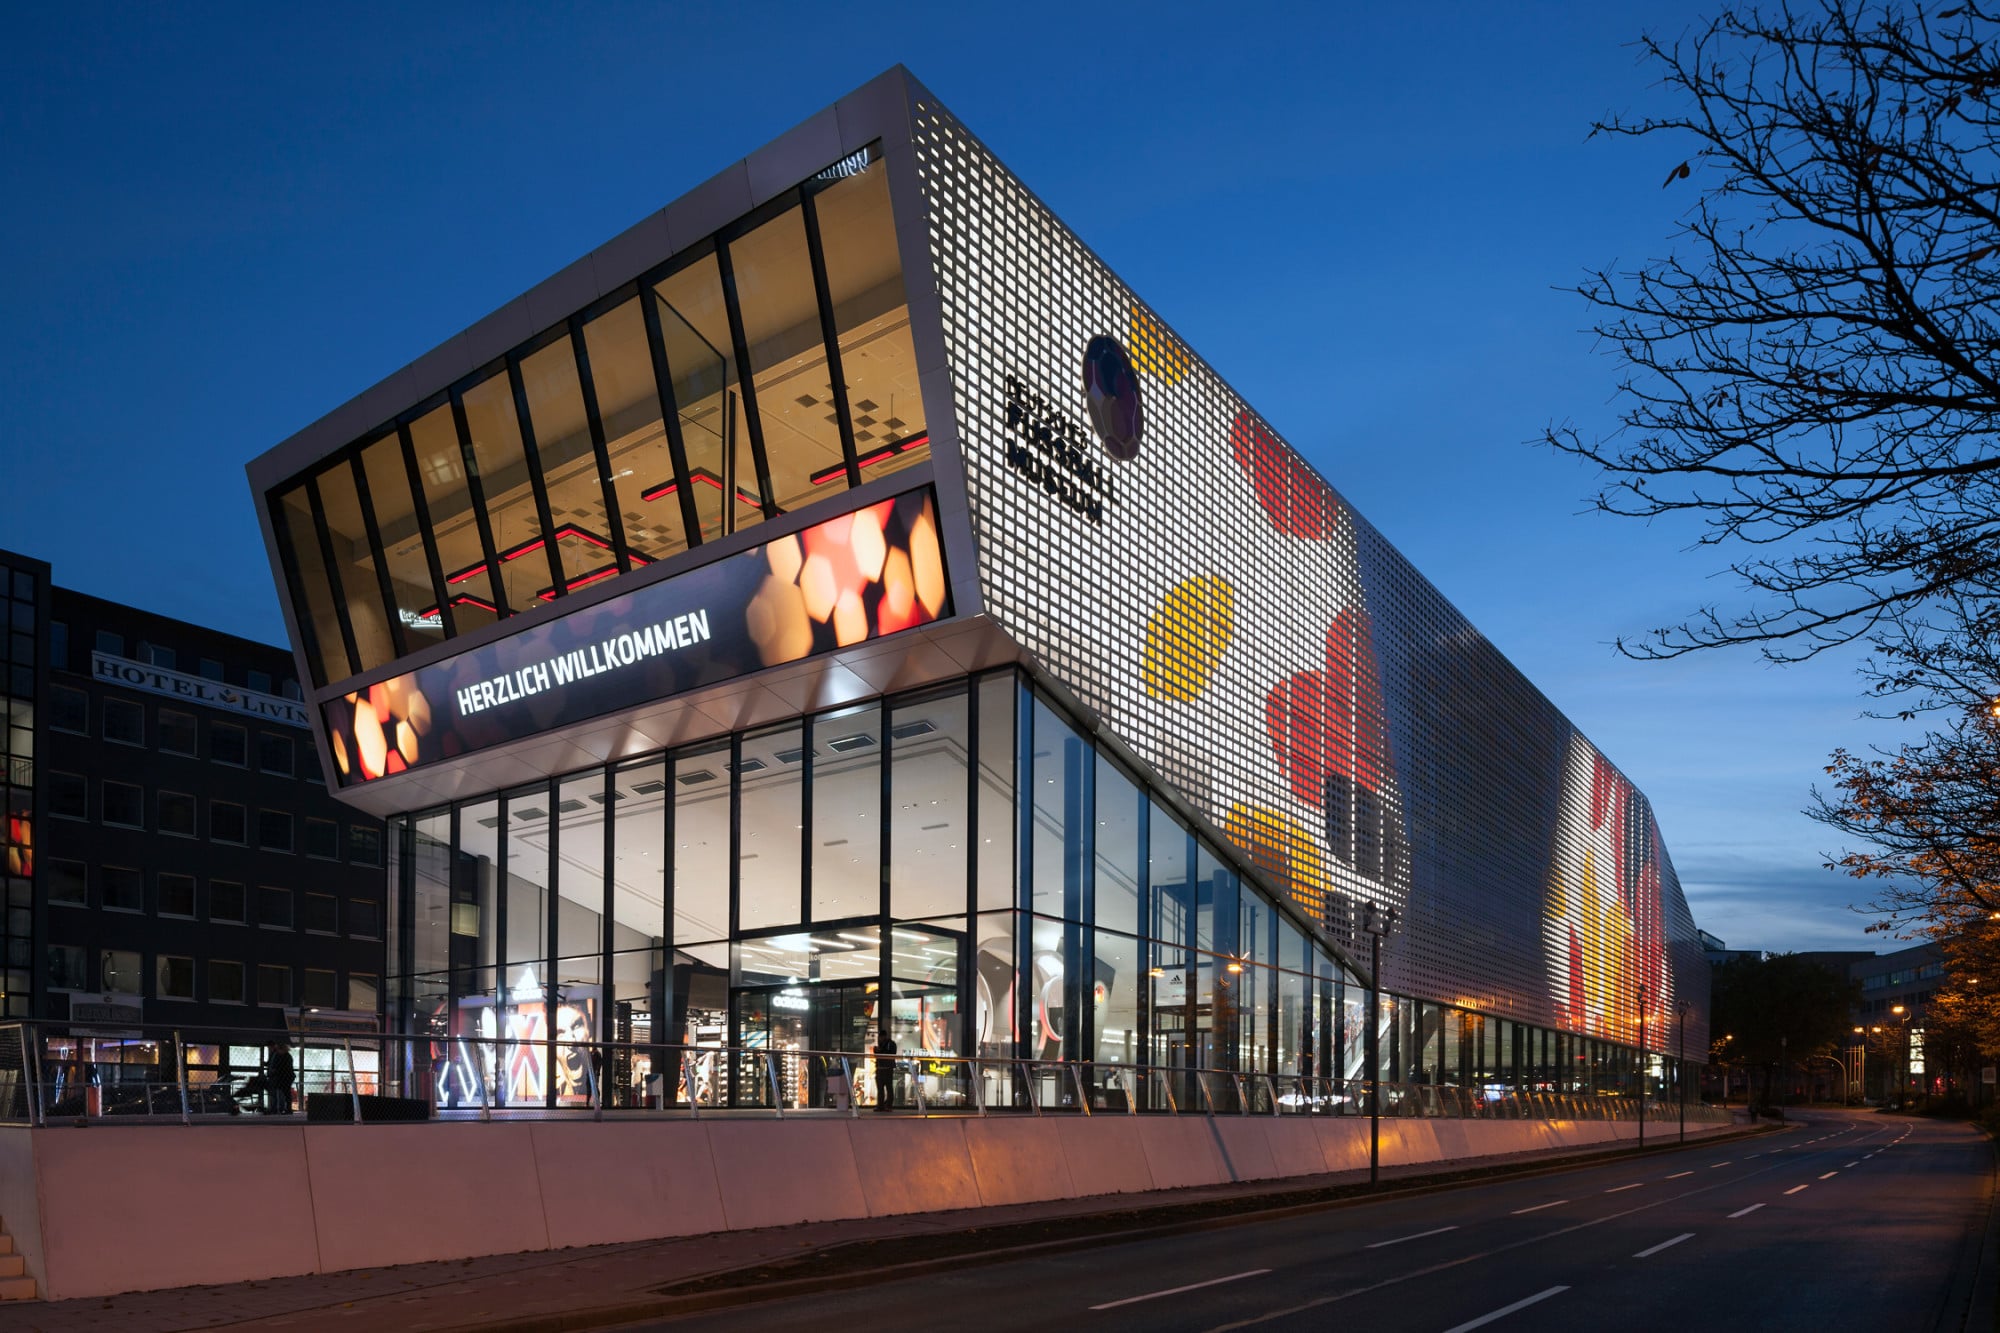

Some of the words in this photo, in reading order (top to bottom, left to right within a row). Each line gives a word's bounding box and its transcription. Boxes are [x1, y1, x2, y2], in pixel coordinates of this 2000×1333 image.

[1006, 374, 1088, 450] DEUTSCHES
[1006, 401, 1114, 500] FUSSBALL
[1006, 438, 1102, 527] MUSEUM
[96, 659, 214, 701] HOTEL
[457, 662, 551, 716] HERZLICH
[550, 608, 711, 686] WILLKOMMEN
